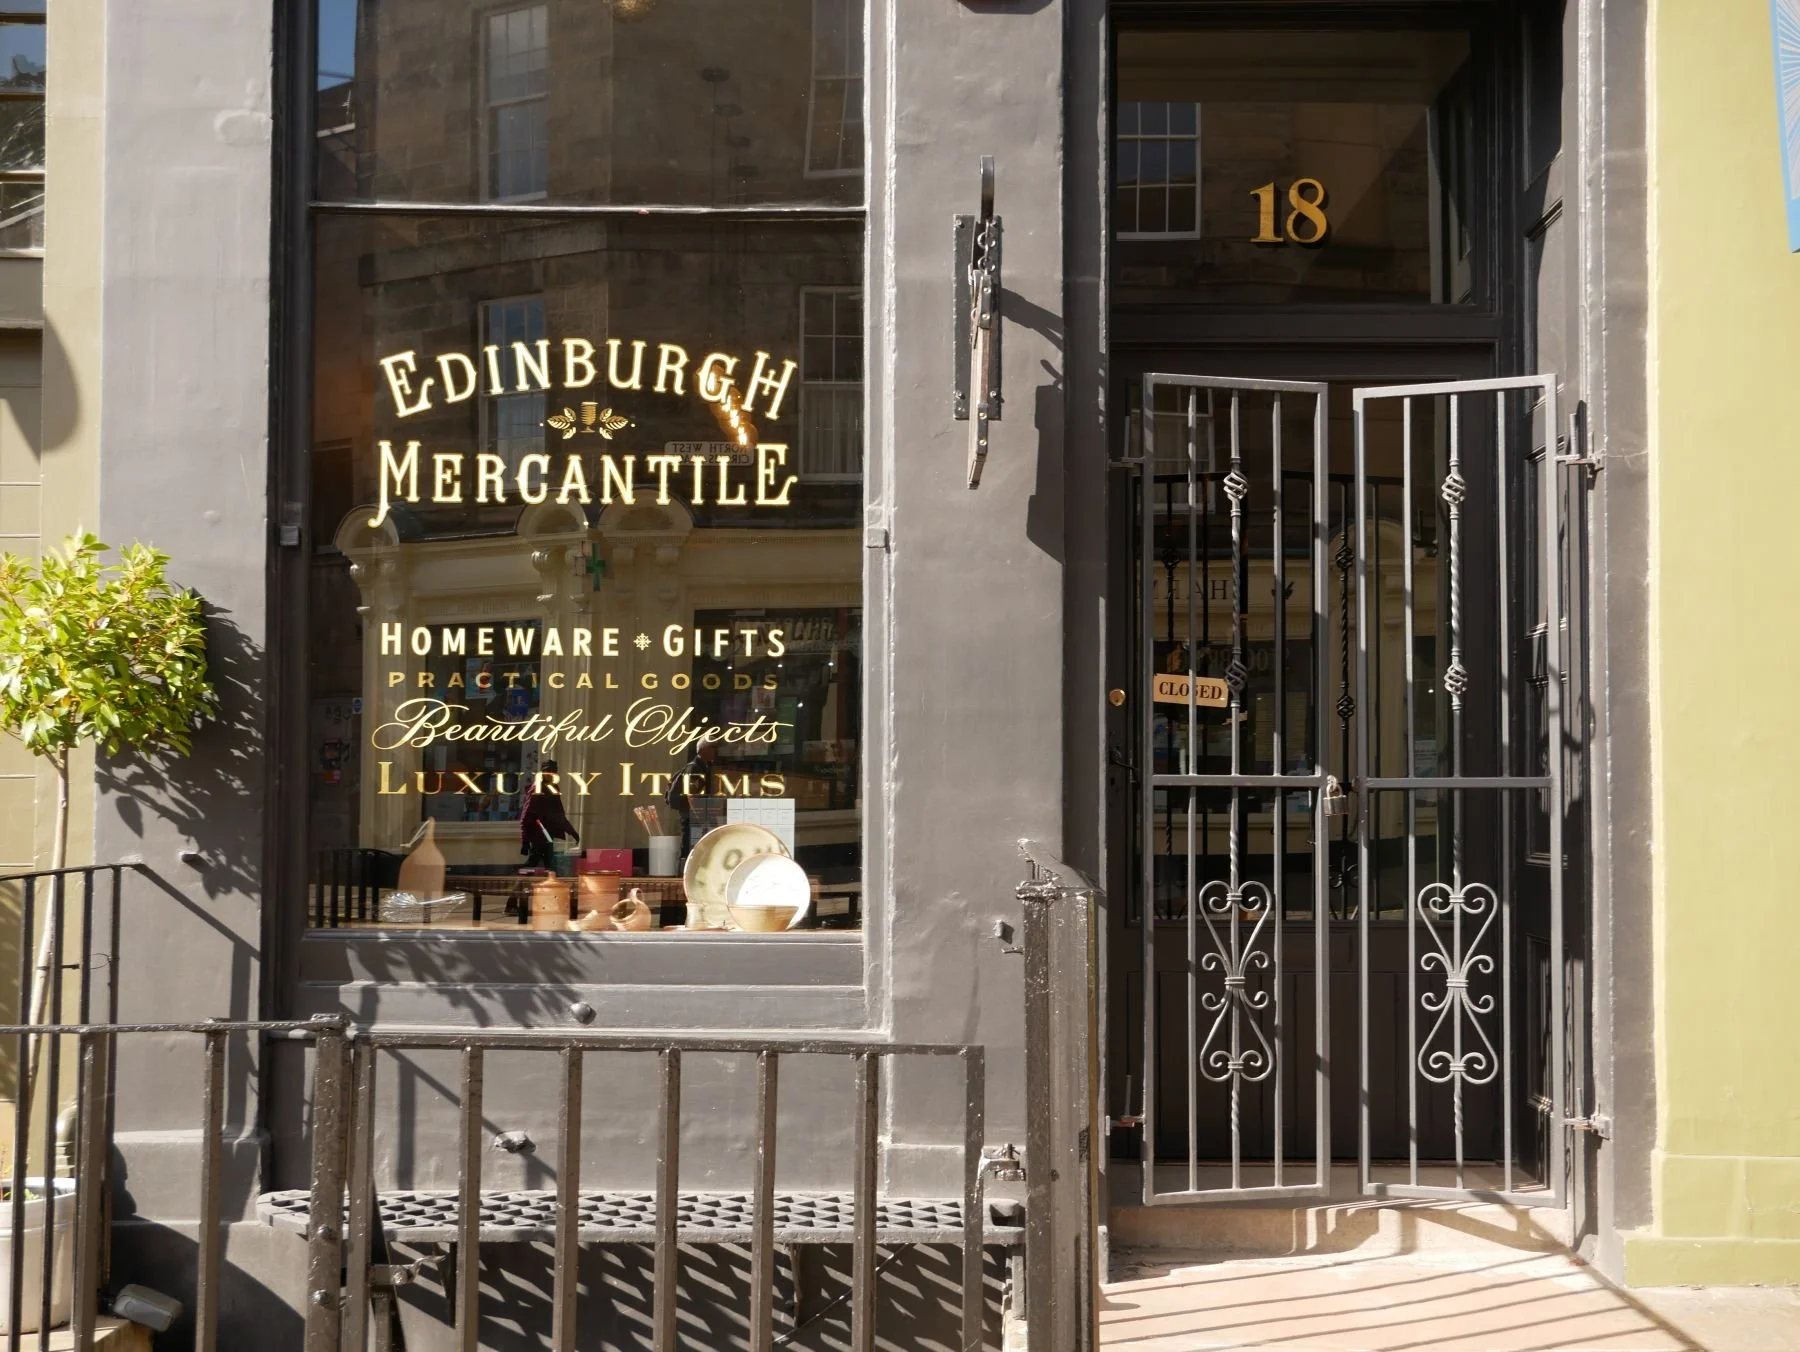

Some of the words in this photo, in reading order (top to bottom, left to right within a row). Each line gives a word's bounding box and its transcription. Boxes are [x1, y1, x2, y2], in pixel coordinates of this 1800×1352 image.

[1249, 178, 1327, 243] 18
[379, 338, 798, 421] EDINBURGH
[368, 440, 798, 528] MERCANTILE
[381, 622, 619, 656] HOMEWARE
[663, 624, 785, 657] GIFTS
[388, 672, 619, 689] PRACTICAL
[641, 673, 778, 690] GOODS
[1159, 681, 1222, 700] CLOED
[372, 698, 614, 754] Beautiful
[625, 697, 794, 756] Objects
[377, 761, 602, 795] LUXURY
[619, 762, 785, 797] ITEMS
